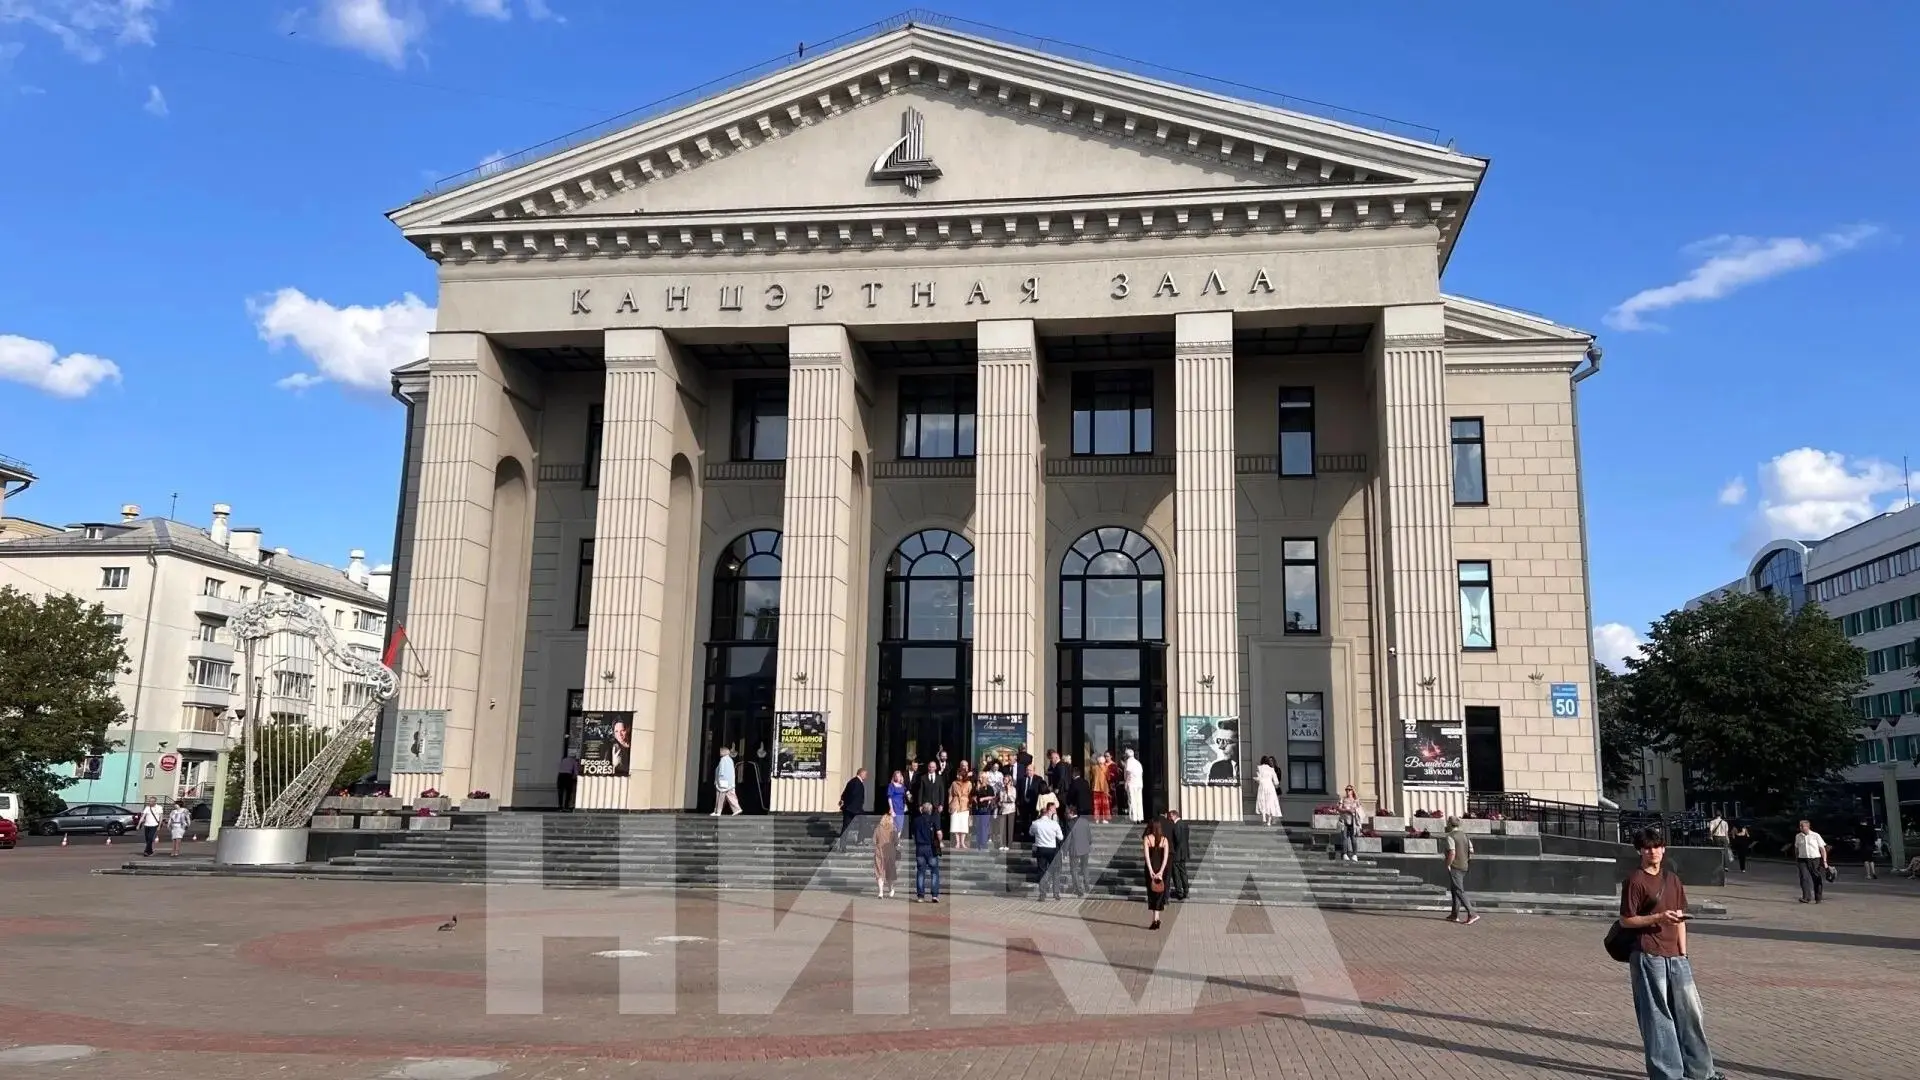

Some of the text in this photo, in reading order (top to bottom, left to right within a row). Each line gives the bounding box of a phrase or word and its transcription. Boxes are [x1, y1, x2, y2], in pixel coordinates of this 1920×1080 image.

[571, 266, 1275, 314] КАНЦЭРТНАЯ ЗАЛА
[1555, 698, 1575, 715] 50
[781, 728, 802, 736] СЕРГЕЙ
[1186, 725, 1199, 734] 25
[1291, 728, 1320, 737] КАВА
[781, 735, 823, 743] РАХМАНИНОВ
[1404, 756, 1461, 768] Волшебство
[1423, 768, 1453, 776] ЗВУКОВ
